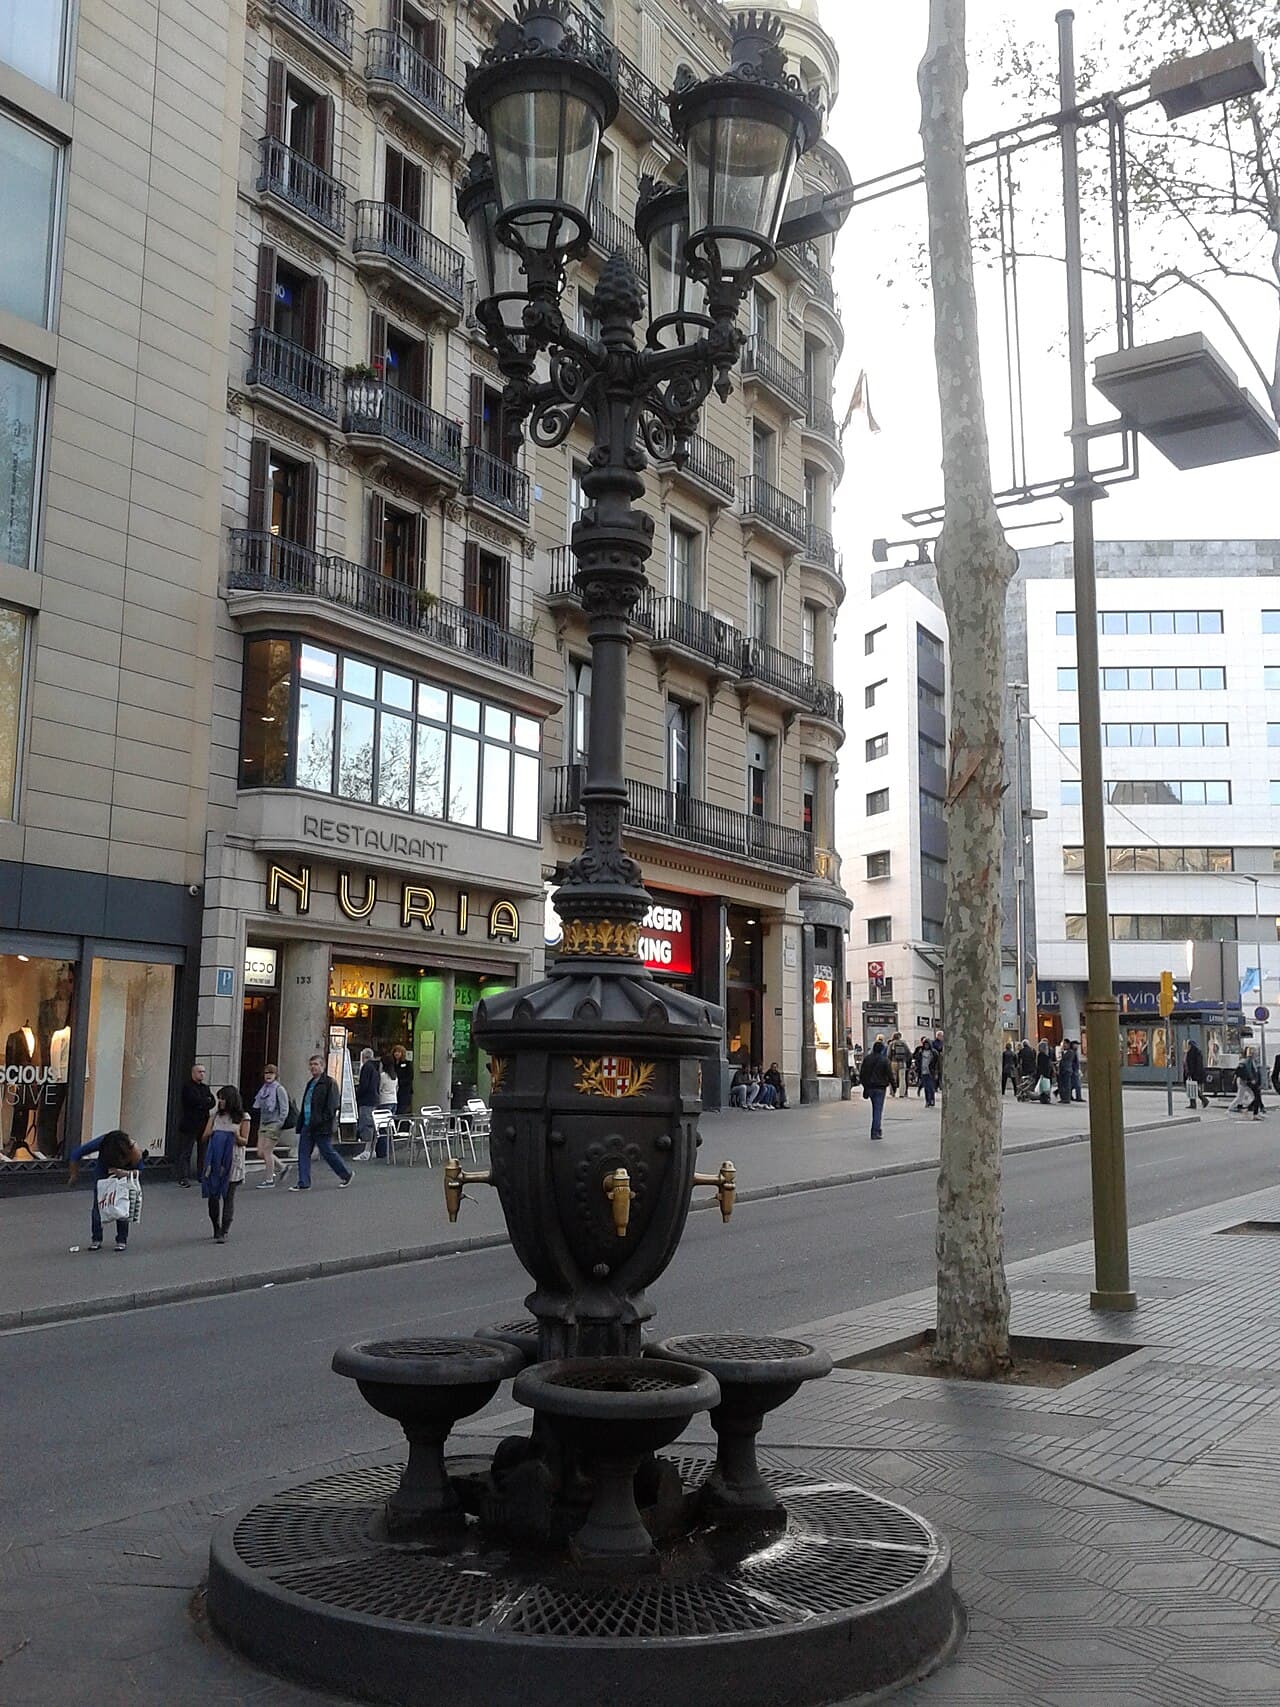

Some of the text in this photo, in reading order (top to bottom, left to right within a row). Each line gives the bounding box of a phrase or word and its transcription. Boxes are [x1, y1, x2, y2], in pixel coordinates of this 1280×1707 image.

[303, 815, 448, 862] RESTAURANT
[266, 862, 520, 942] NURIA
[640, 905, 682, 933] RGER
[296, 976, 312, 985] 133
[378, 982, 417, 1001] PAELLES
